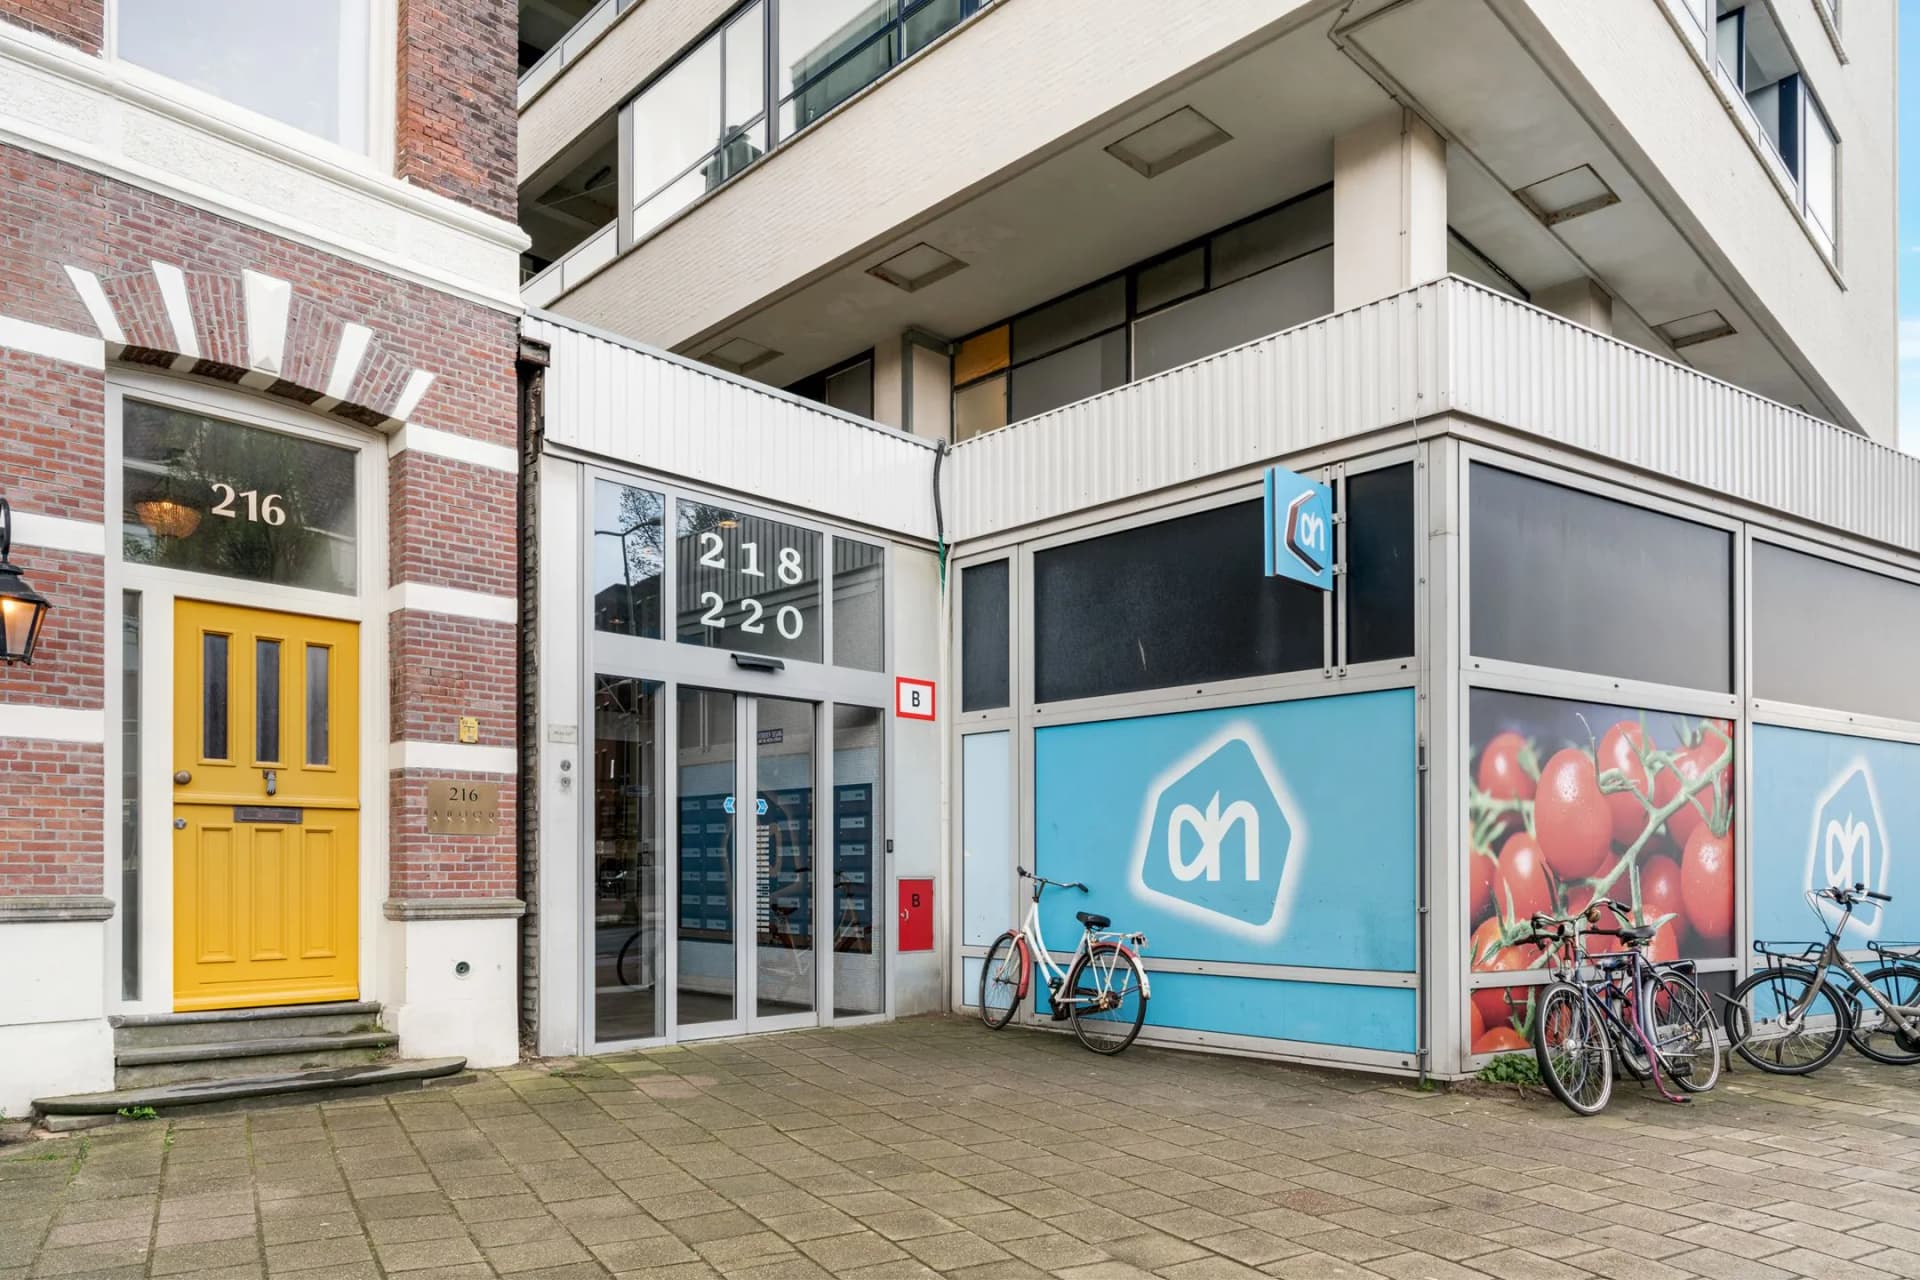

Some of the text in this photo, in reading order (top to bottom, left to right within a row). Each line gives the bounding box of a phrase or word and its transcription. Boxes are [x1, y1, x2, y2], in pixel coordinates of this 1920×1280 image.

[211, 483, 286, 526] 216
[700, 532, 803, 585] 218
[700, 591, 804, 640] 220
[912, 690, 921, 708] B
[449, 787, 478, 802] 216
[912, 893, 921, 908] B
